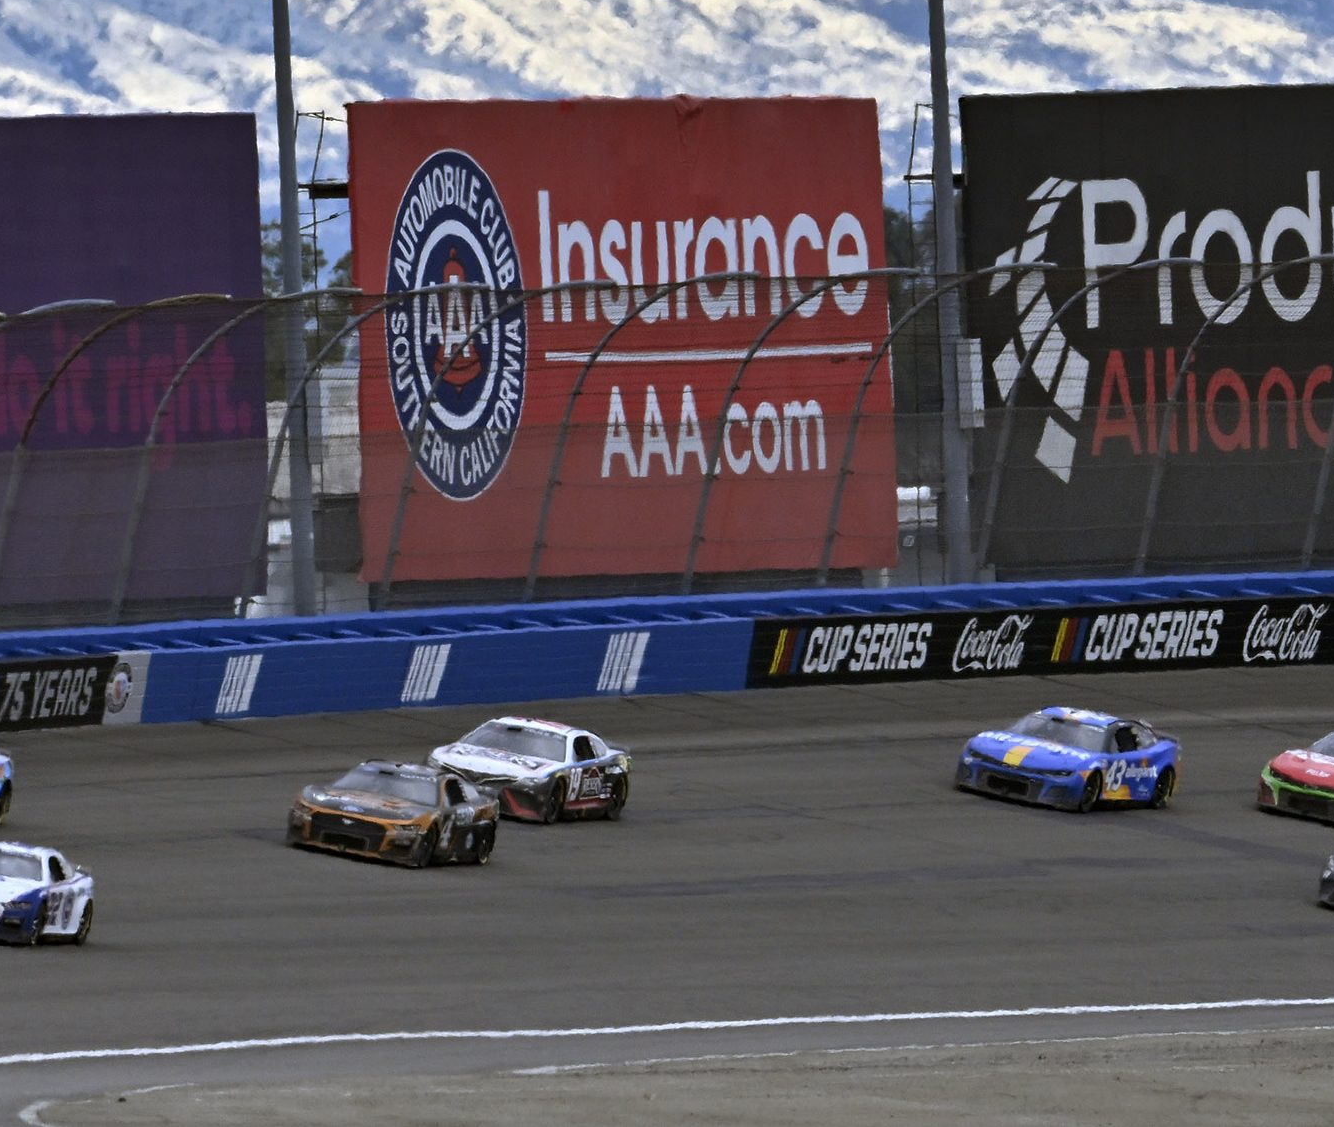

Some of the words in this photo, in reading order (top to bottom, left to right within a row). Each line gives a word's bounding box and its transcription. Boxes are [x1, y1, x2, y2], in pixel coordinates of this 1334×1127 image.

[394, 165, 482, 288] AUTOMOBILE
[480, 197, 515, 291] CLUB
[537, 190, 869, 325] Insurance
[425, 274, 489, 358] AAA
[51, 318, 96, 434] it
[459, 318, 523, 486] CALIFORNIA
[600, 385, 828, 478] AAA.com
[802, 625, 854, 673] CUP
[848, 622, 933, 671] SERIES
[1086, 612, 1141, 662] CUP
[1134, 609, 1224, 660] SERIES
[30, 666, 98, 720] YEARS
[1105, 759, 1127, 791] 43
